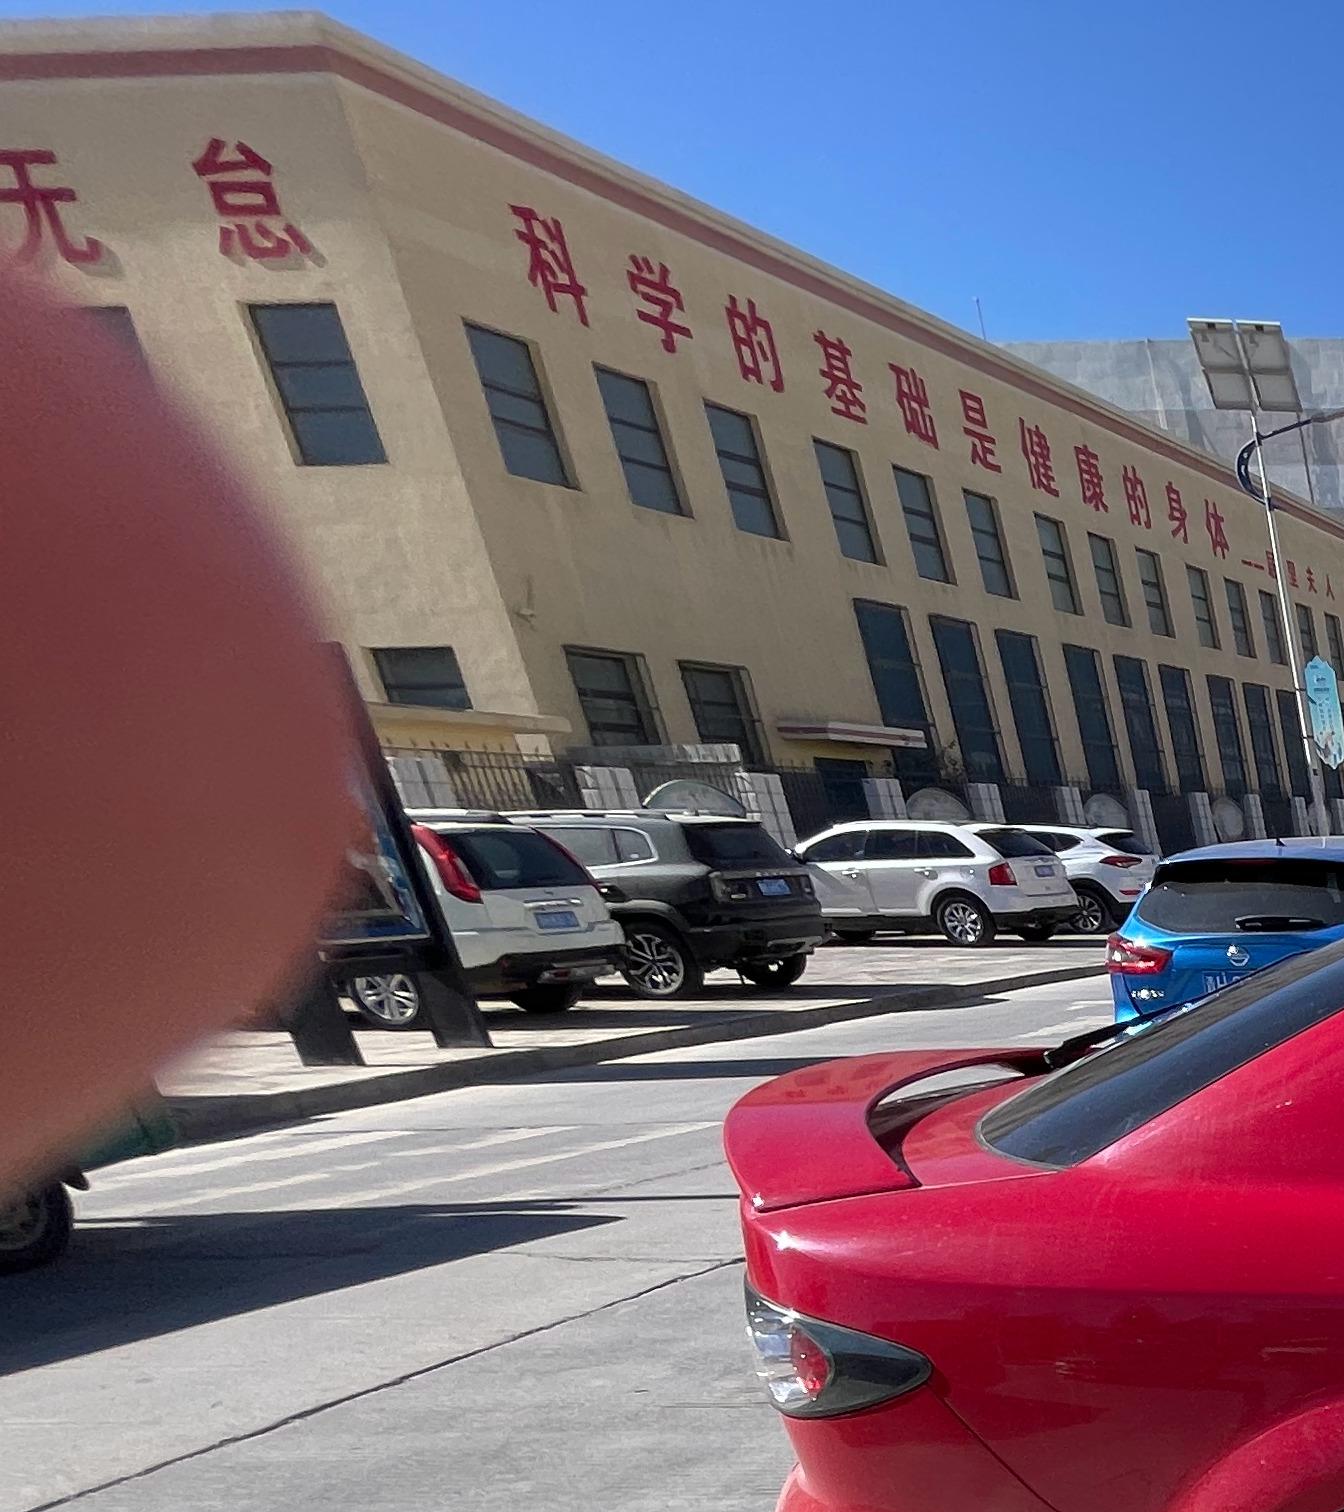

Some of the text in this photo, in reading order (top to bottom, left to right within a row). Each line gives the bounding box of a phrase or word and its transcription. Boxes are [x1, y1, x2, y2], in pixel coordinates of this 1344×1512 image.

[508, 204, 1230, 560] 科学的基础是健康的身体
